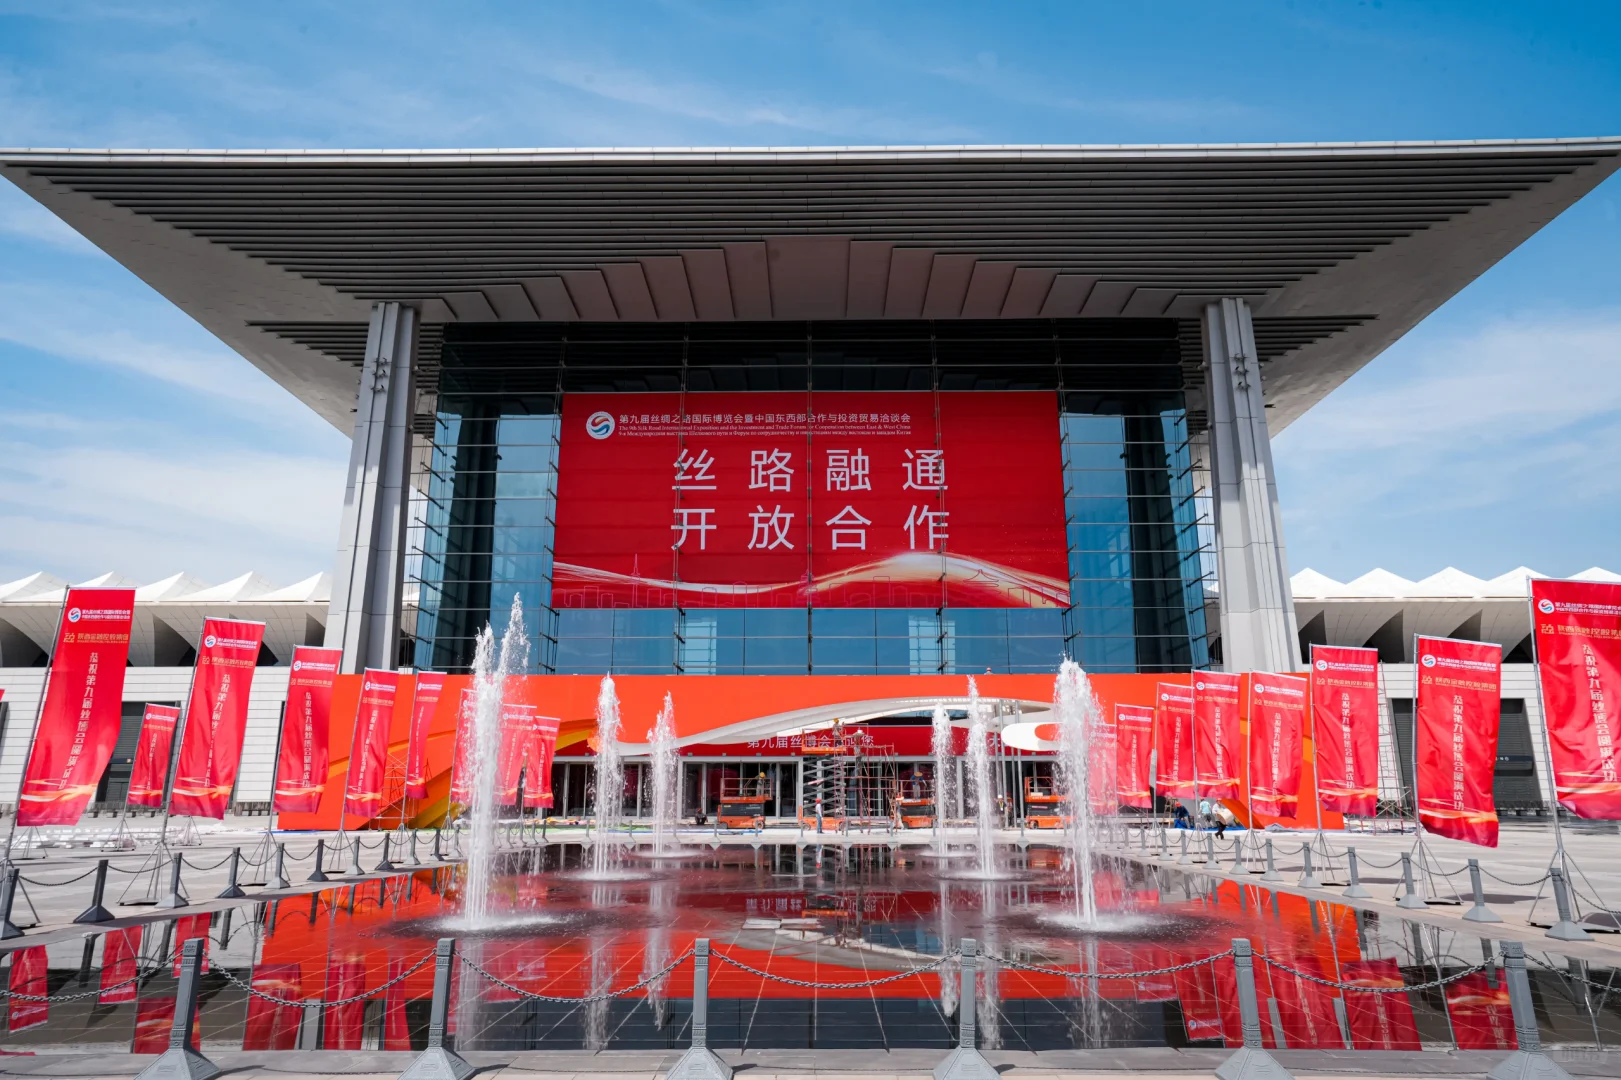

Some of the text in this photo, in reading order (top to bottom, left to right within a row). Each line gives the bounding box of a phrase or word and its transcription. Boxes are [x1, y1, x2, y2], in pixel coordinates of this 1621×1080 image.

[672, 447, 949, 492] 丝路融通
[670, 504, 950, 551] 开放合作
[747, 734, 874, 748] 第九届丝博会您
